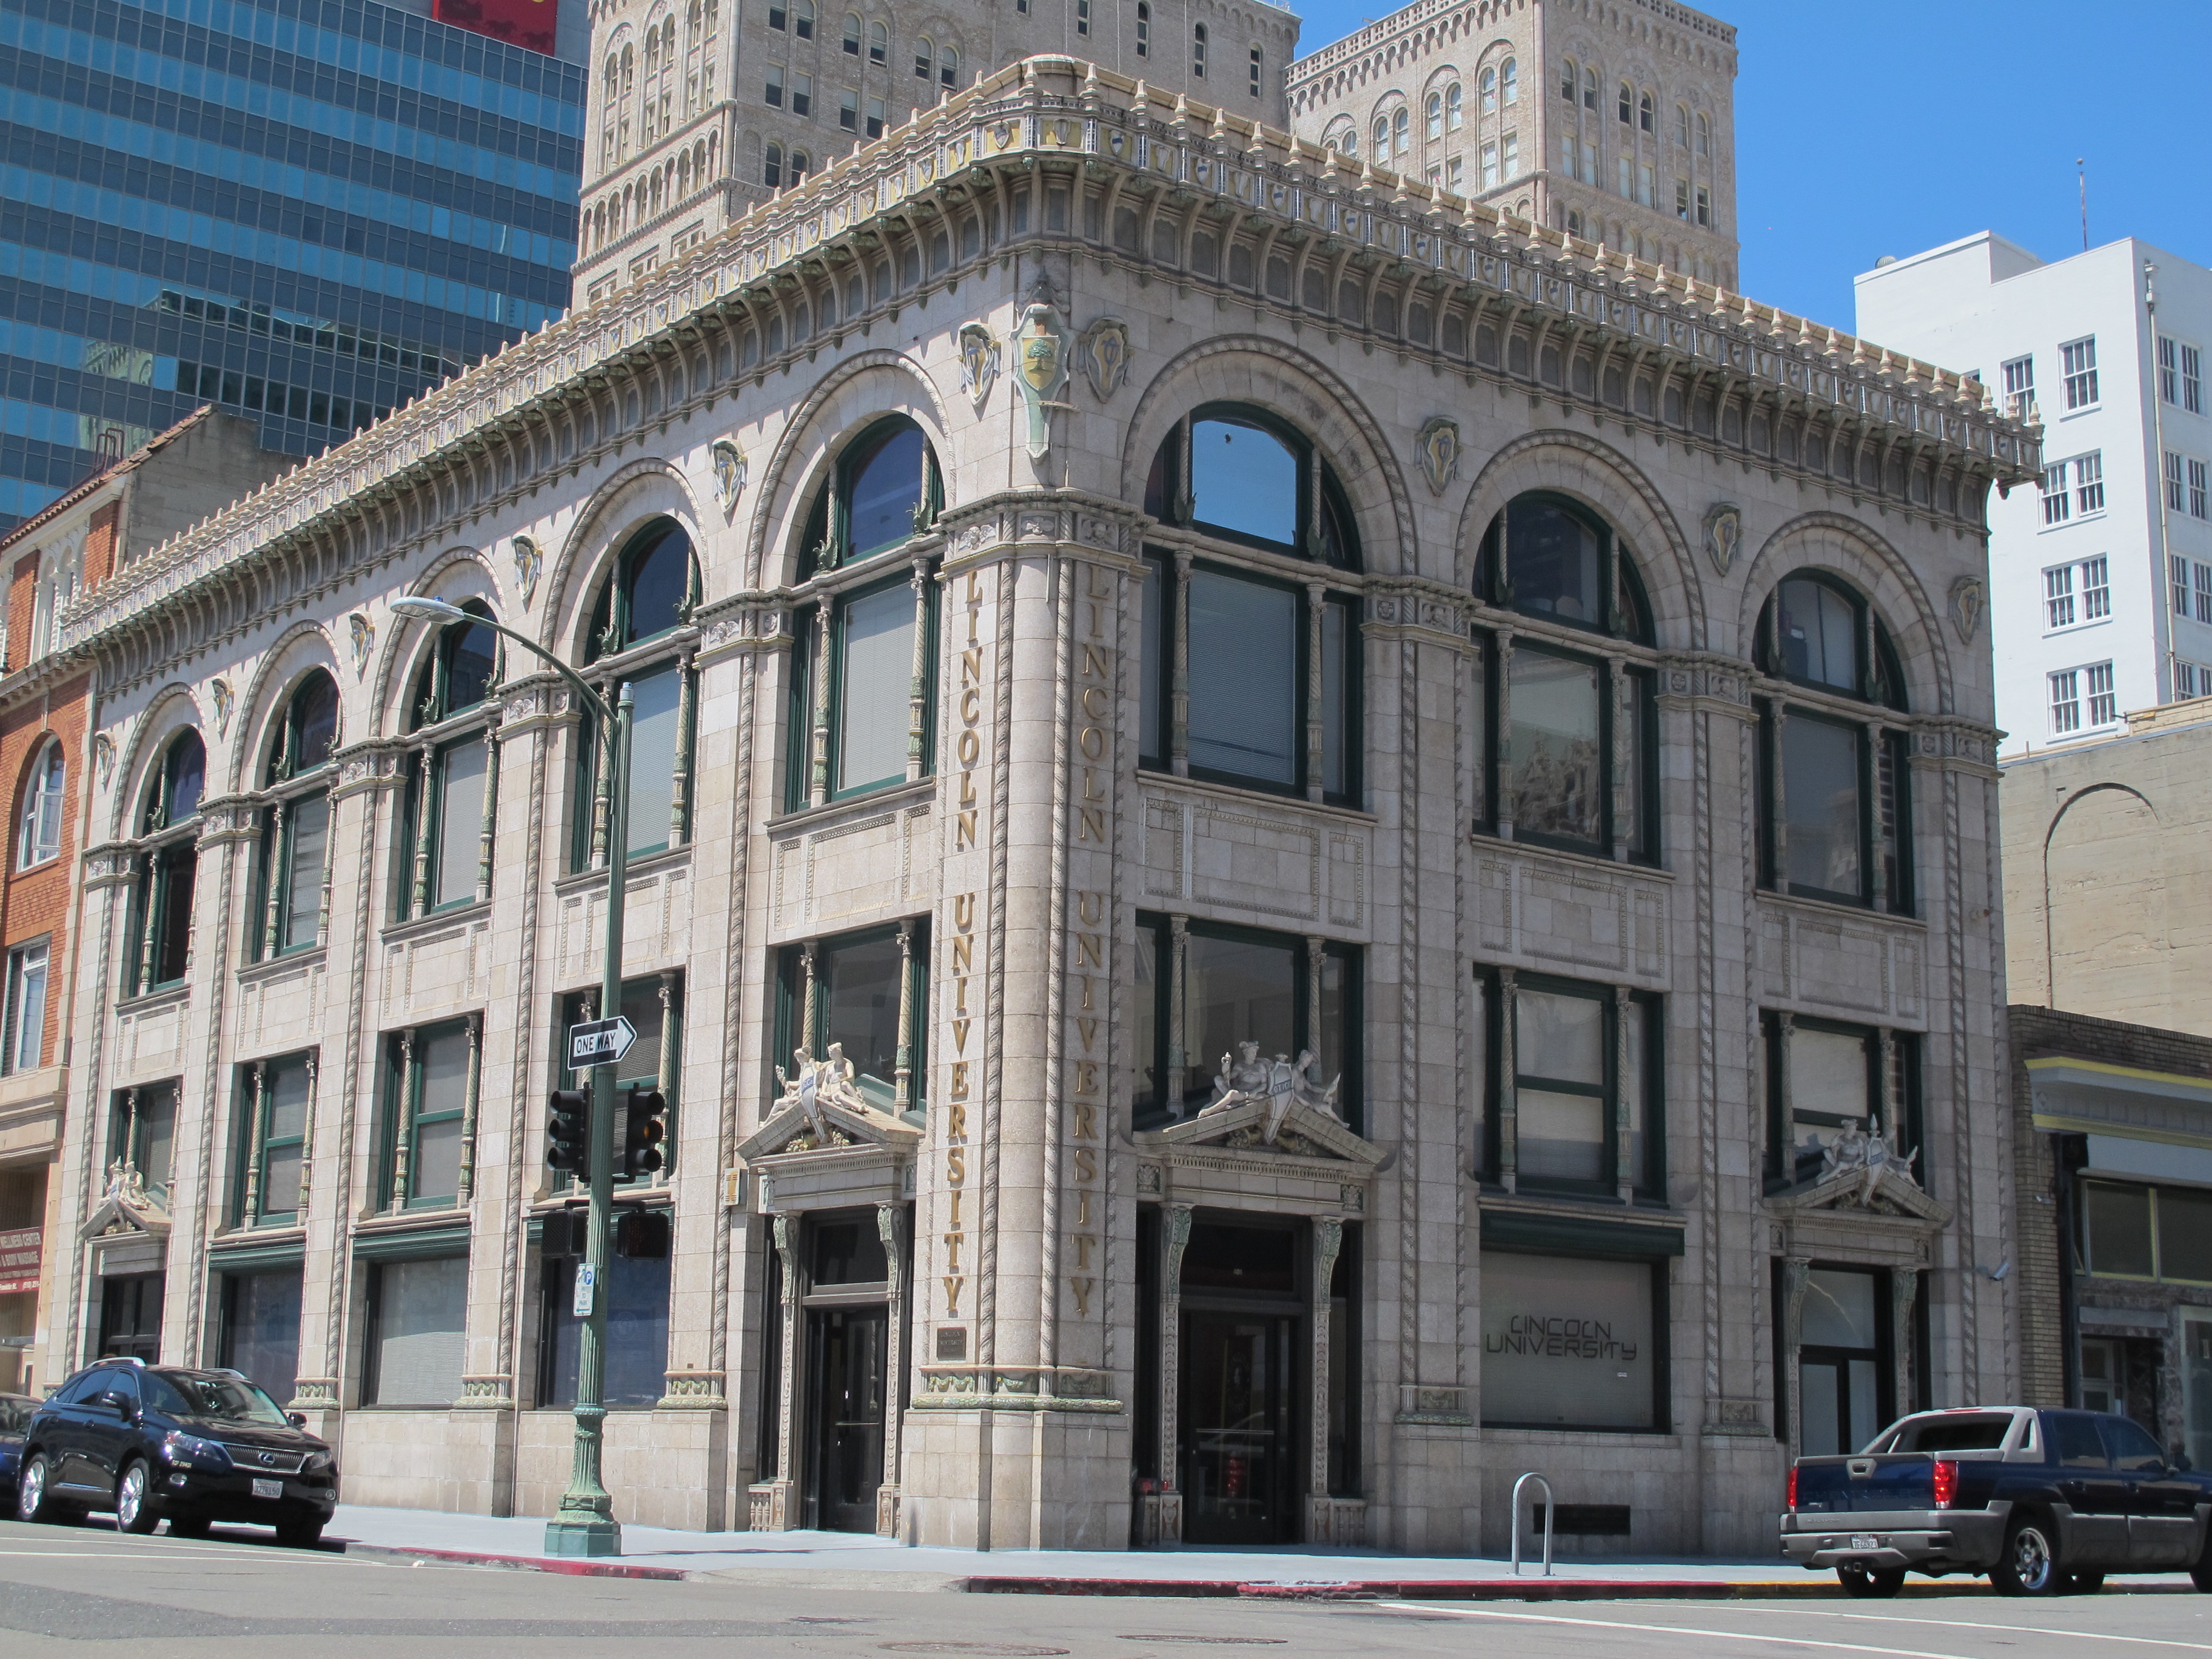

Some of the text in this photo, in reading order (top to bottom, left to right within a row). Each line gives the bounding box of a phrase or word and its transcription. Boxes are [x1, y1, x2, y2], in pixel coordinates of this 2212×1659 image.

[956, 568, 983, 848] LINCOLN
[1068, 563, 1109, 1314] LINCOLN UNIVERSITY
[577, 1032, 617, 1054] ONE WAY
[942, 892, 976, 1312] UNIVERSITY
[1486, 1333, 1637, 1361] UNIVERSITY
[1510, 1315, 1611, 1340] LINCOLN
